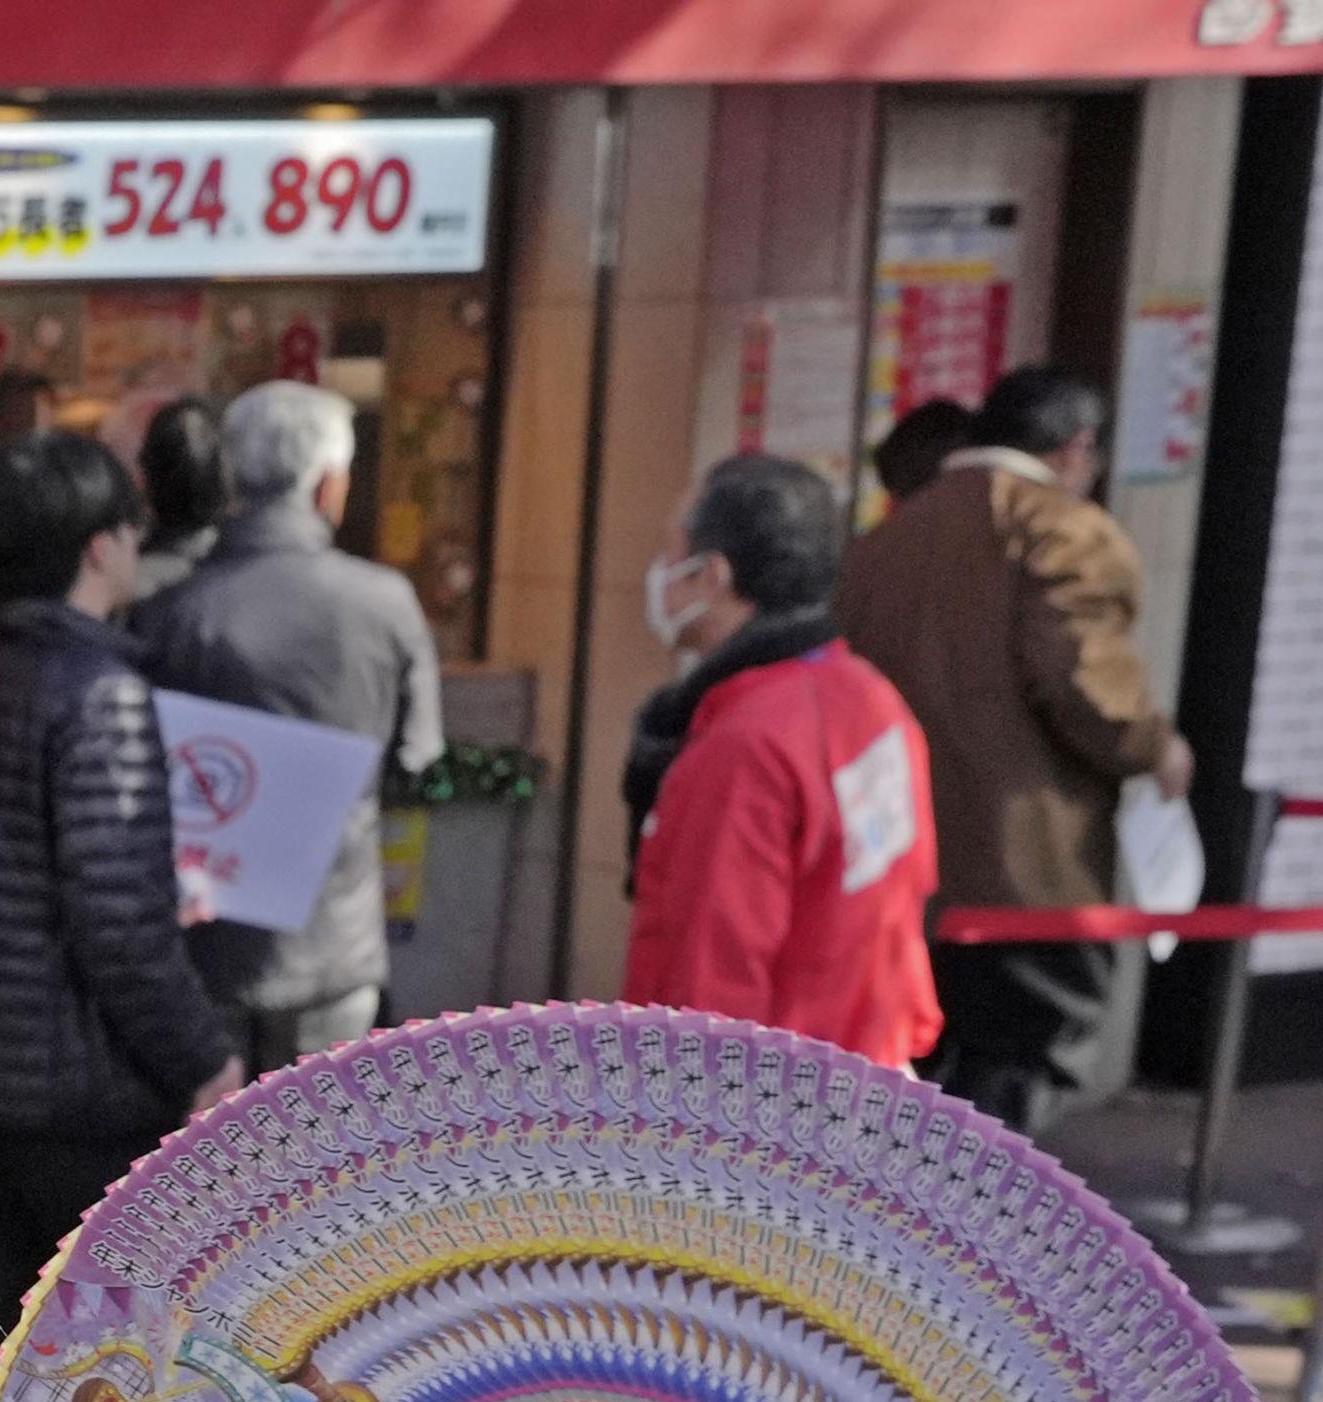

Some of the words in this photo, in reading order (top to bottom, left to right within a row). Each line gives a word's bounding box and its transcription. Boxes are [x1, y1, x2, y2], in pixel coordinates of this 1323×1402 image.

[264, 156, 413, 235] 890
[89, 1243, 282, 1360] 年末ジャンボミニ
